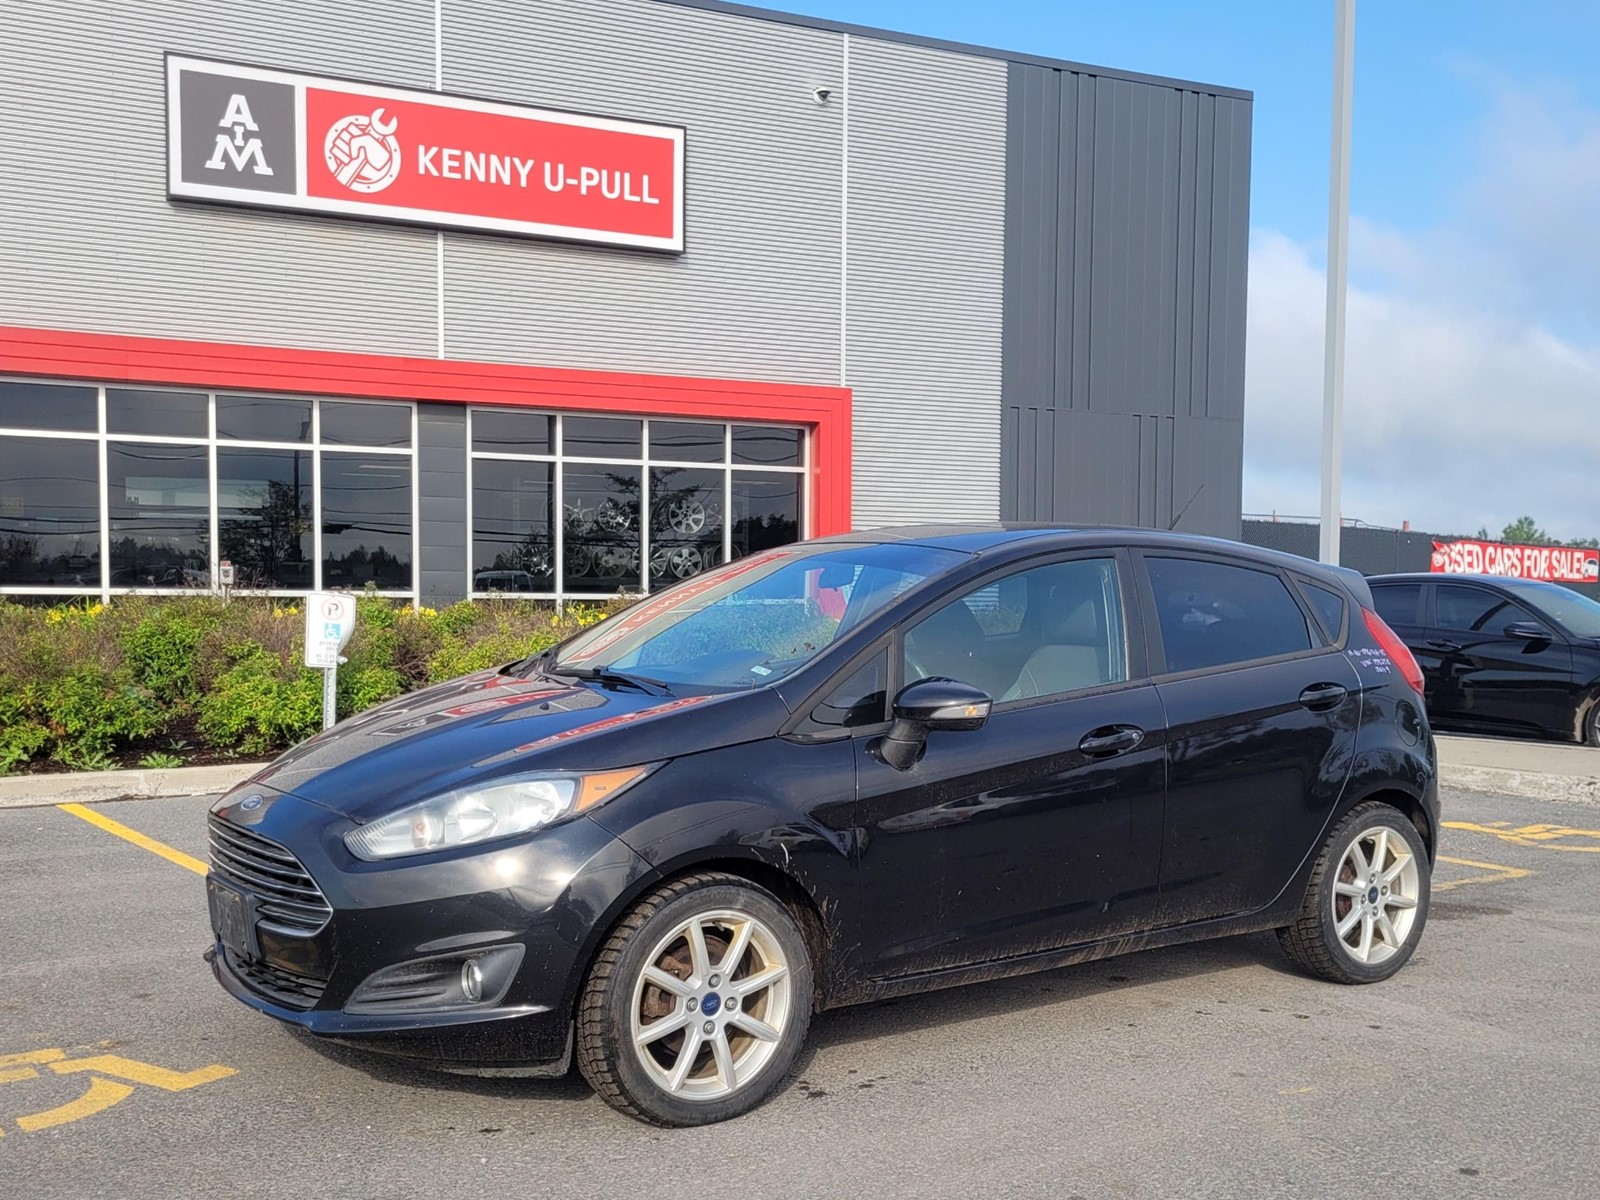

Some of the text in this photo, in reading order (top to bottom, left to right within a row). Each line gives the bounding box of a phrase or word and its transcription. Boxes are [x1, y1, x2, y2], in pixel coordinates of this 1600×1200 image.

[205, 93, 274, 176] AIM
[418, 144, 660, 205] KENNY U-PULL
[1444, 543, 1483, 574] USED
[1485, 546, 1522, 578] CARS
[1523, 548, 1551, 578] FOR
